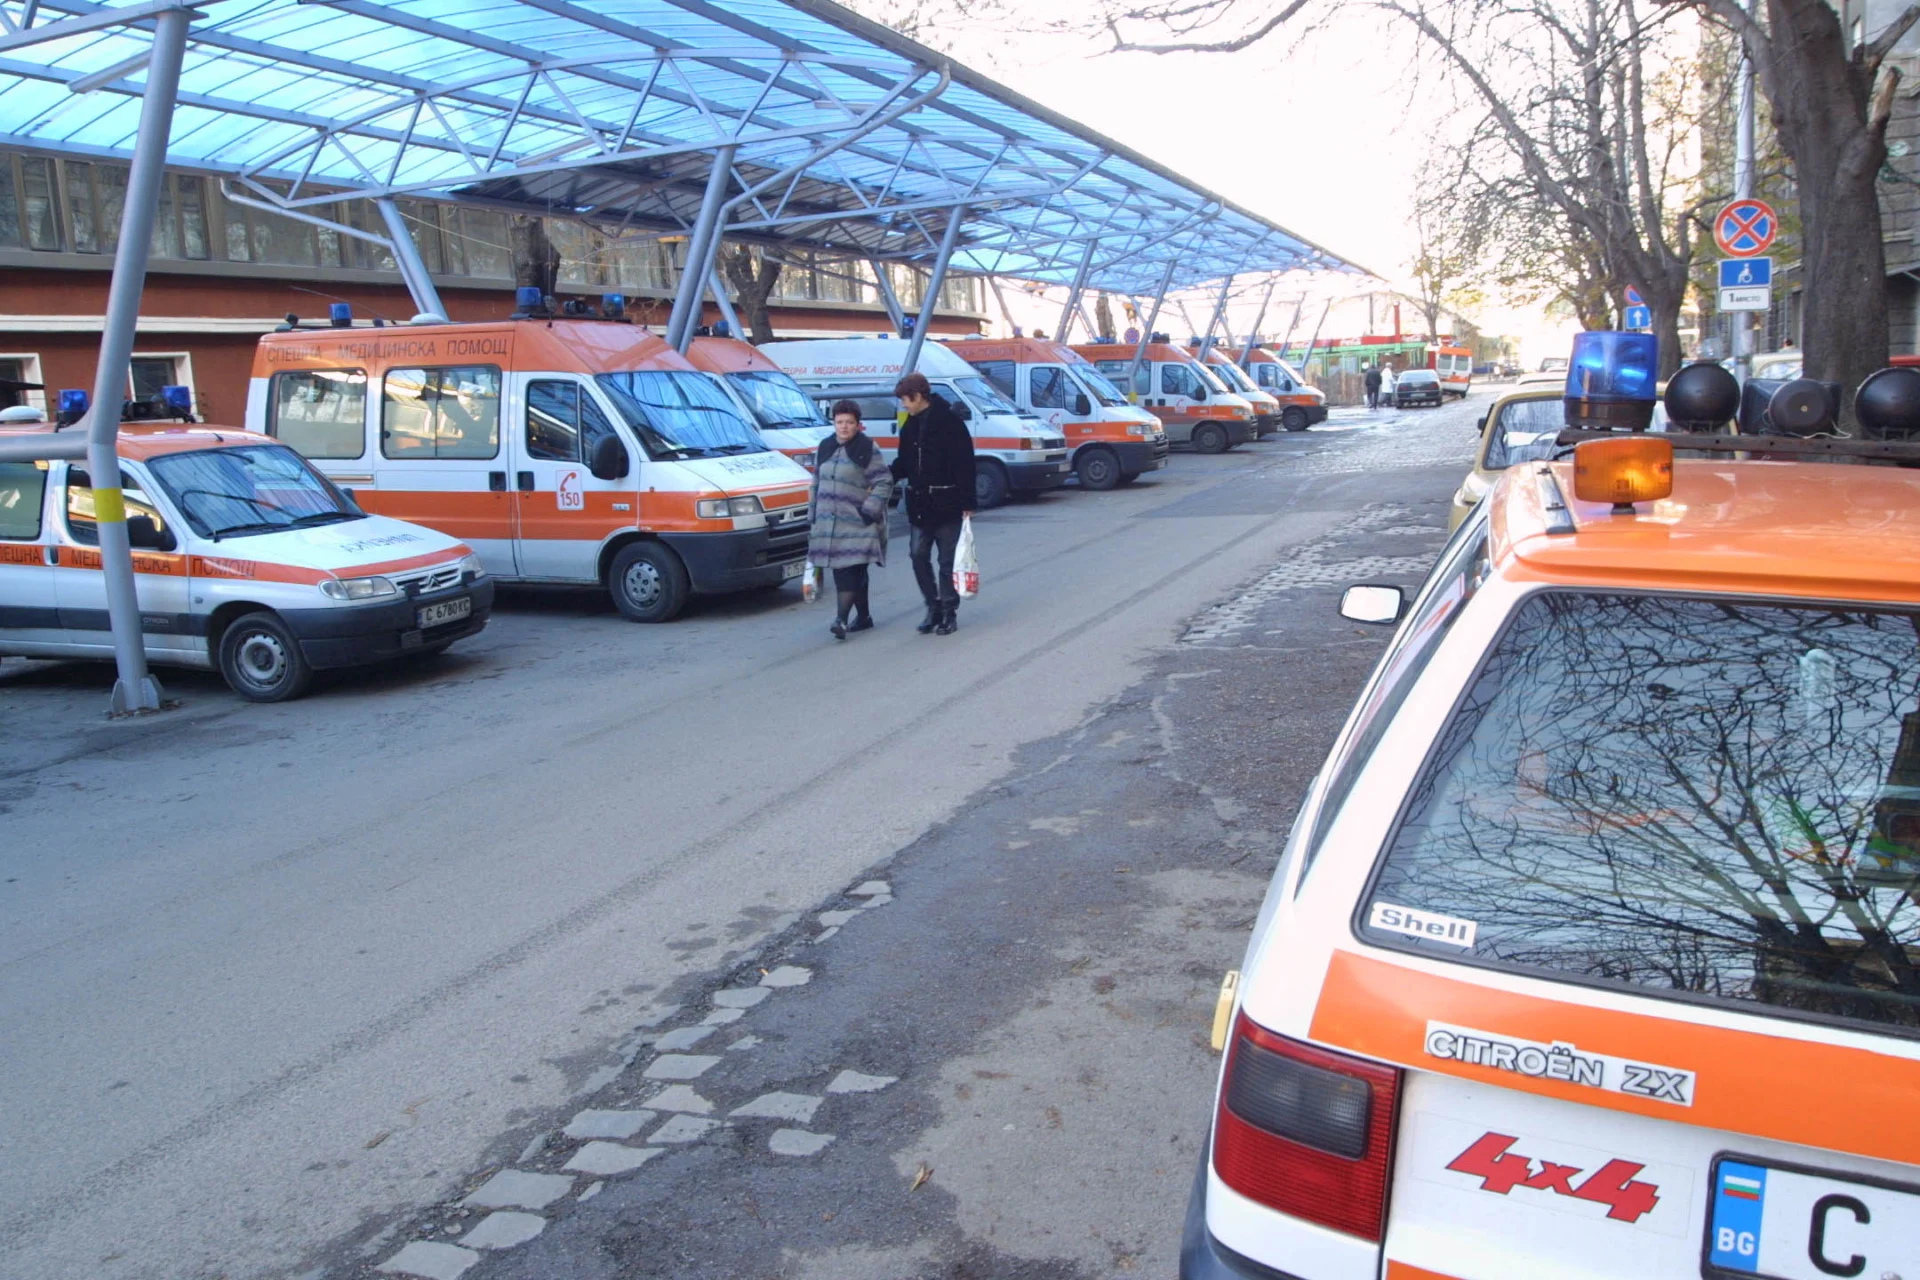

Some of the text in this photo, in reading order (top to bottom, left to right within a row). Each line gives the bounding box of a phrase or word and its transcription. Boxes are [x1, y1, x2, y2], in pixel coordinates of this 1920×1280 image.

[267, 338, 507, 362] СПЕШНА МЕДИЦИНСКА ПОМОЩ
[560, 492, 579, 507] 150
[0, 546, 41, 563] ЕШНА
[193, 557, 256, 578] ПОМОЩ
[1380, 907, 1468, 941] Shell
[1427, 1030, 1688, 1102] CITROËN ZX
[1445, 1131, 1660, 1224] 4x4
[1717, 1227, 1756, 1256] BG
[1808, 1193, 1871, 1278] C
